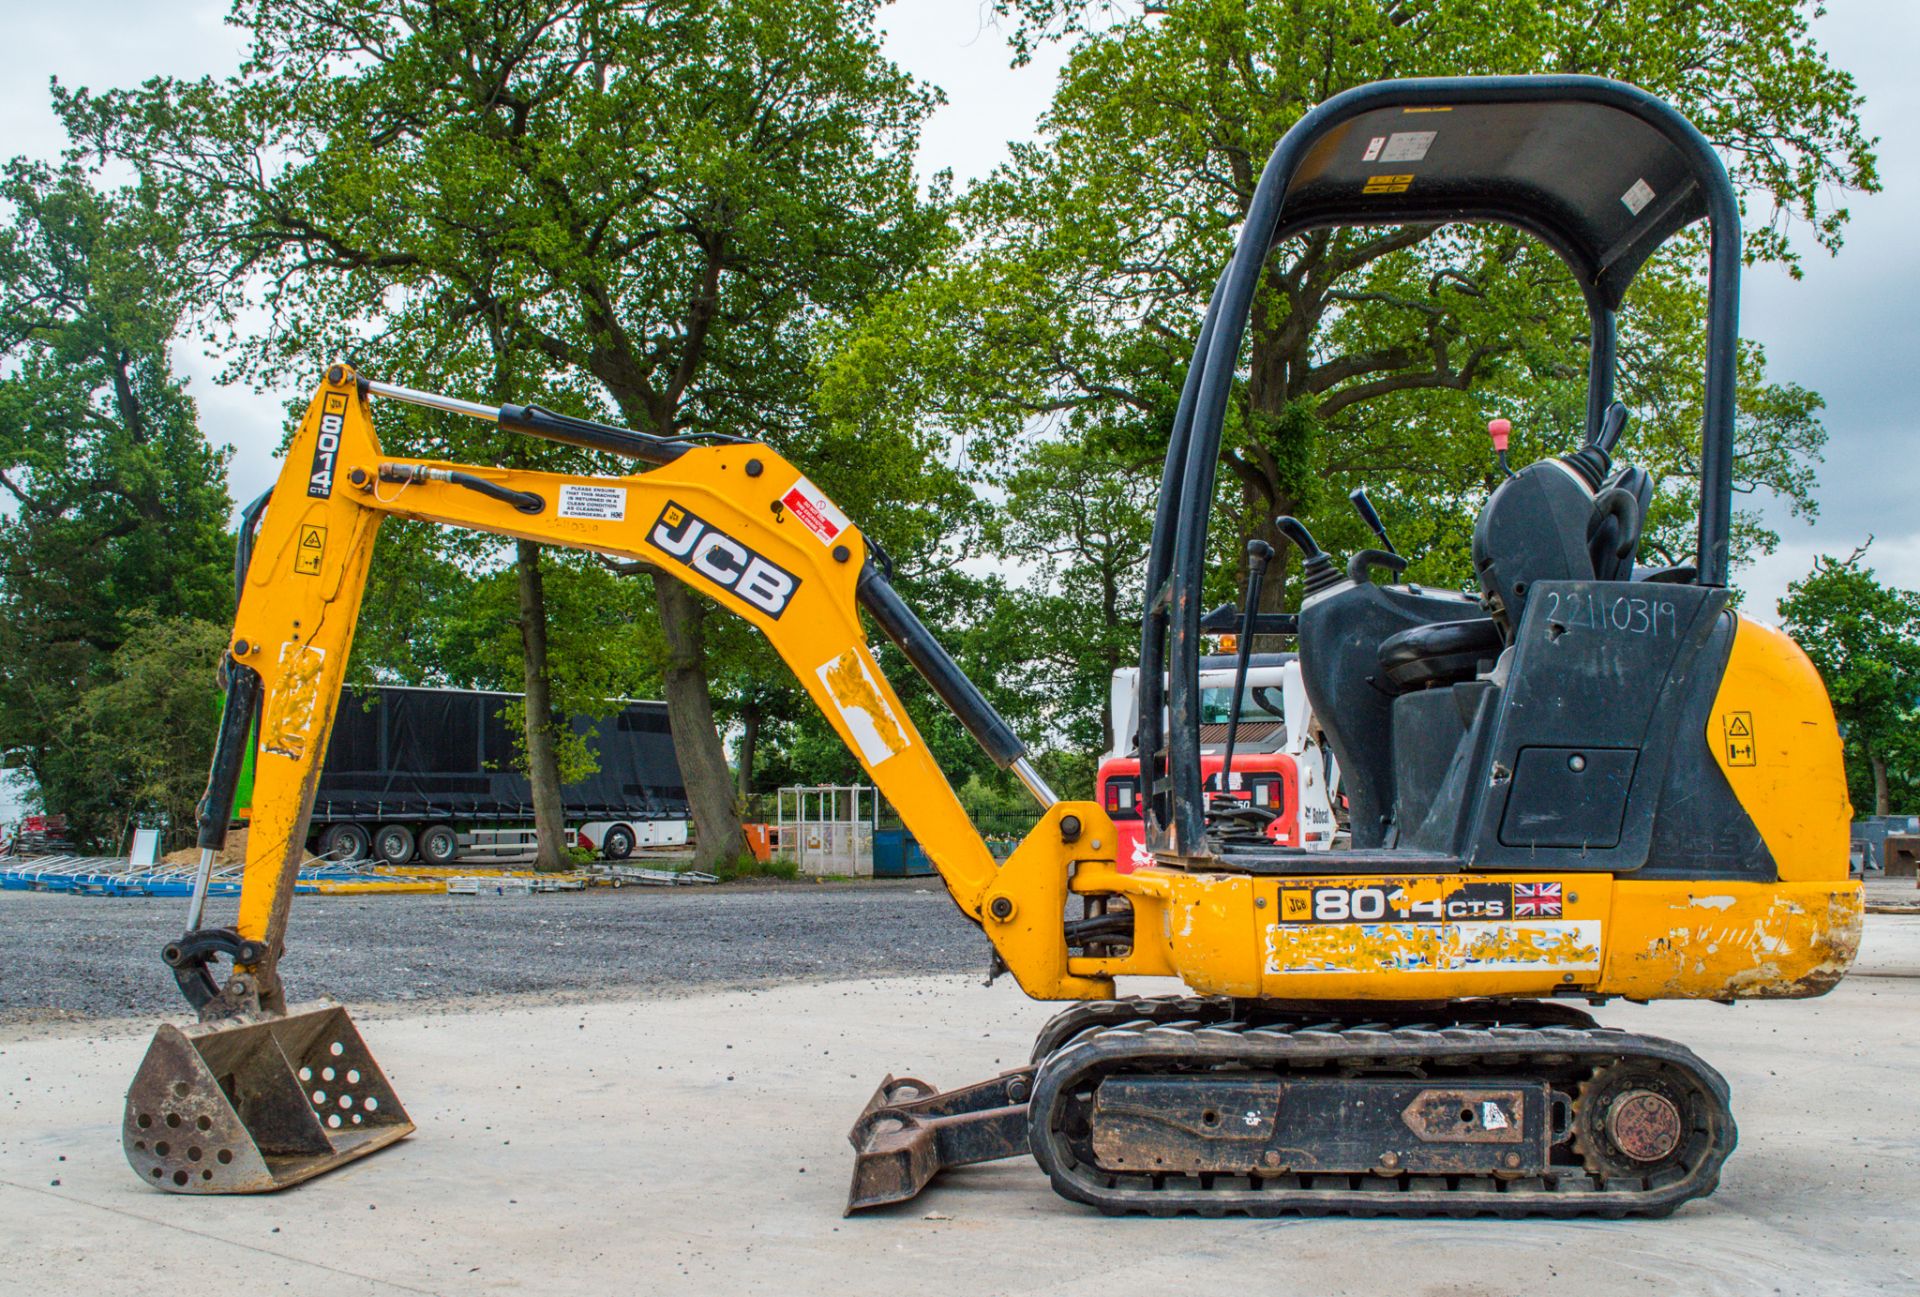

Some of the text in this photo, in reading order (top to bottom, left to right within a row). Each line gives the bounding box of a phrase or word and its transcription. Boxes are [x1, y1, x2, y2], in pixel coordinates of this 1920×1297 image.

[311, 414, 343, 488] 8014
[309, 486, 330, 495] CTS
[809, 507, 818, 515] NOT
[653, 519, 793, 613] JCB
[1547, 592, 1676, 639] 22110319
[1289, 898, 1306, 912] JCB
[1448, 900, 1504, 917] CTS
